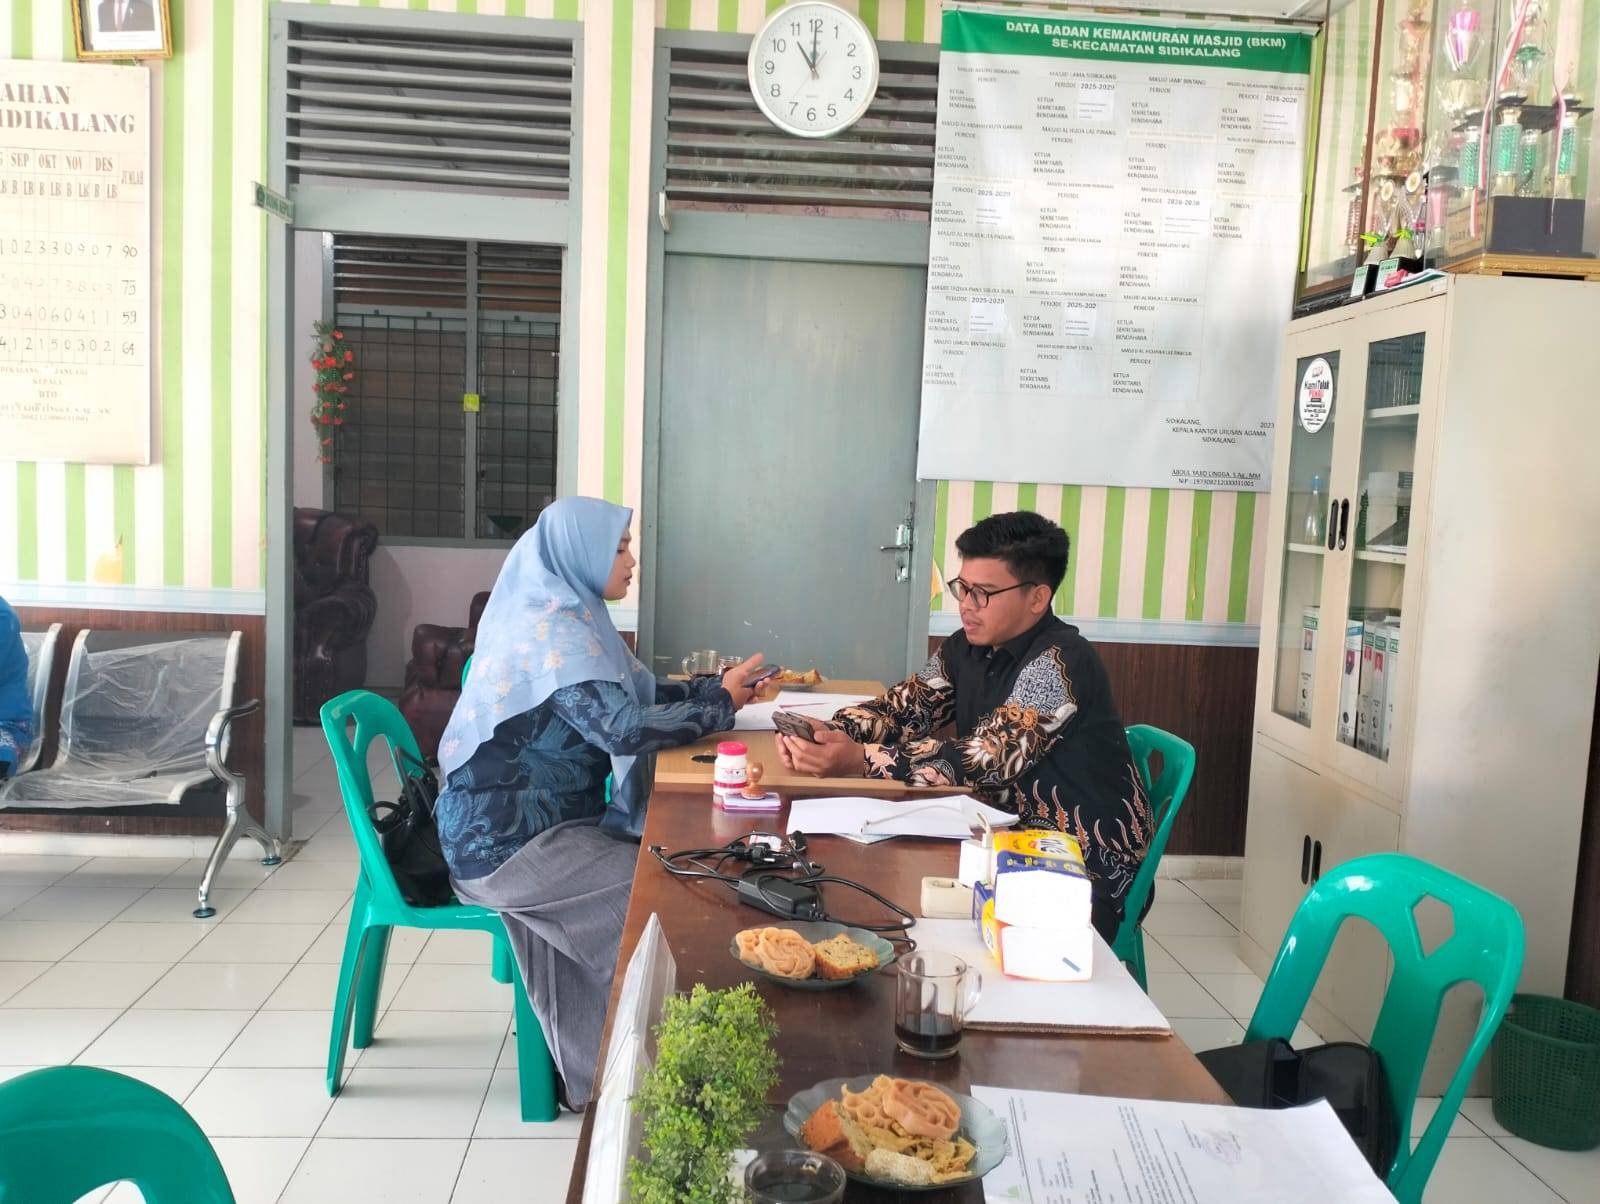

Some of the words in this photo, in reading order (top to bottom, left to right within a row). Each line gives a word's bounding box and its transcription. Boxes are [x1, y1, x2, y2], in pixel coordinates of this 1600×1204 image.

[790, 22, 801, 36] 11
[808, 18, 824, 33] 12
[833, 24, 839, 40] 1
[1006, 21, 1040, 34] DATA
[1043, 24, 1089, 38] BADAN
[1093, 28, 1189, 44] KEMAKMURAN
[1193, 34, 1242, 46] MASJID
[1246, 37, 1286, 50] (BKM)
[772, 38, 787, 53] 10
[847, 43, 857, 57] 2
[1052, 38, 1154, 54] SE-KECAMATAN
[1158, 46, 1241, 57] SIDIKALANG
[764, 60, 775, 75] 9
[852, 66, 862, 80] 3
[770, 83, 781, 98] 8
[843, 87, 854, 102] 4
[789, 101, 799, 116] 7
[806, 107, 817, 121] 6
[827, 103, 837, 118] 5
[10, 152, 29, 168] SEP
[38, 154, 56, 169] OKT
[95, 157, 113, 171] DES
